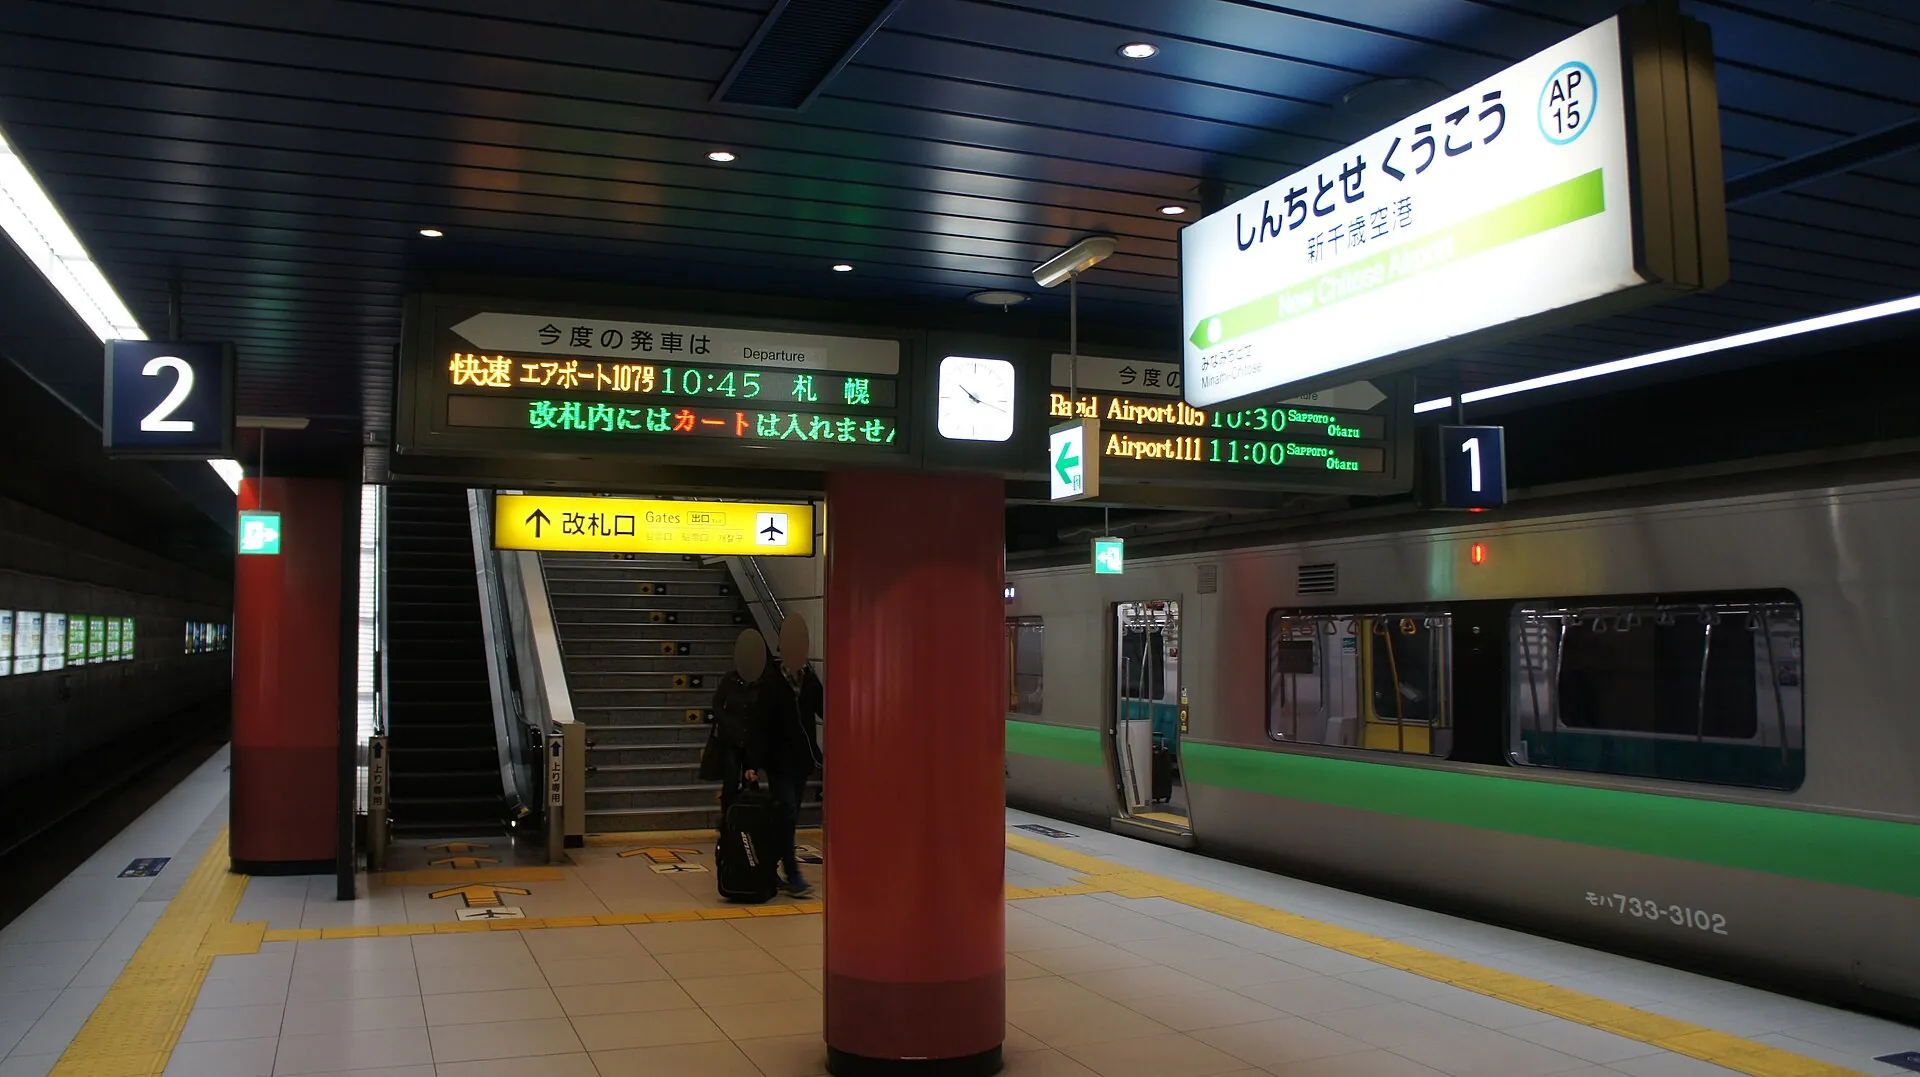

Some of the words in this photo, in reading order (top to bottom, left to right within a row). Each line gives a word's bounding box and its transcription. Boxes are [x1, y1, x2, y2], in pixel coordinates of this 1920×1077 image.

[1549, 70, 1582, 108] AP
[1552, 101, 1581, 136] 15
[1235, 153, 1367, 252] しんちとせ
[1380, 89, 1507, 182] くうこう
[1306, 195, 1414, 264] 新千歳空港
[537, 322, 712, 357] 今度の発車は
[742, 346, 806, 363] Departure
[140, 355, 195, 432] 2
[449, 353, 513, 388] 快速
[520, 361, 656, 394] エアポート107号
[662, 367, 761, 399] 10:45
[1105, 433, 1202, 461] Airport111
[1209, 438, 1285, 466] 11:00
[1327, 424, 1360, 438] Otaru
[1325, 457, 1359, 471] Otaru
[1461, 437, 1482, 492] 1
[562, 512, 635, 537] 改札口
[645, 511, 681, 524] Gates
[691, 514, 710, 523] 出口
[373, 763, 383, 806] 上り専用
[552, 762, 561, 803] 上り専用
